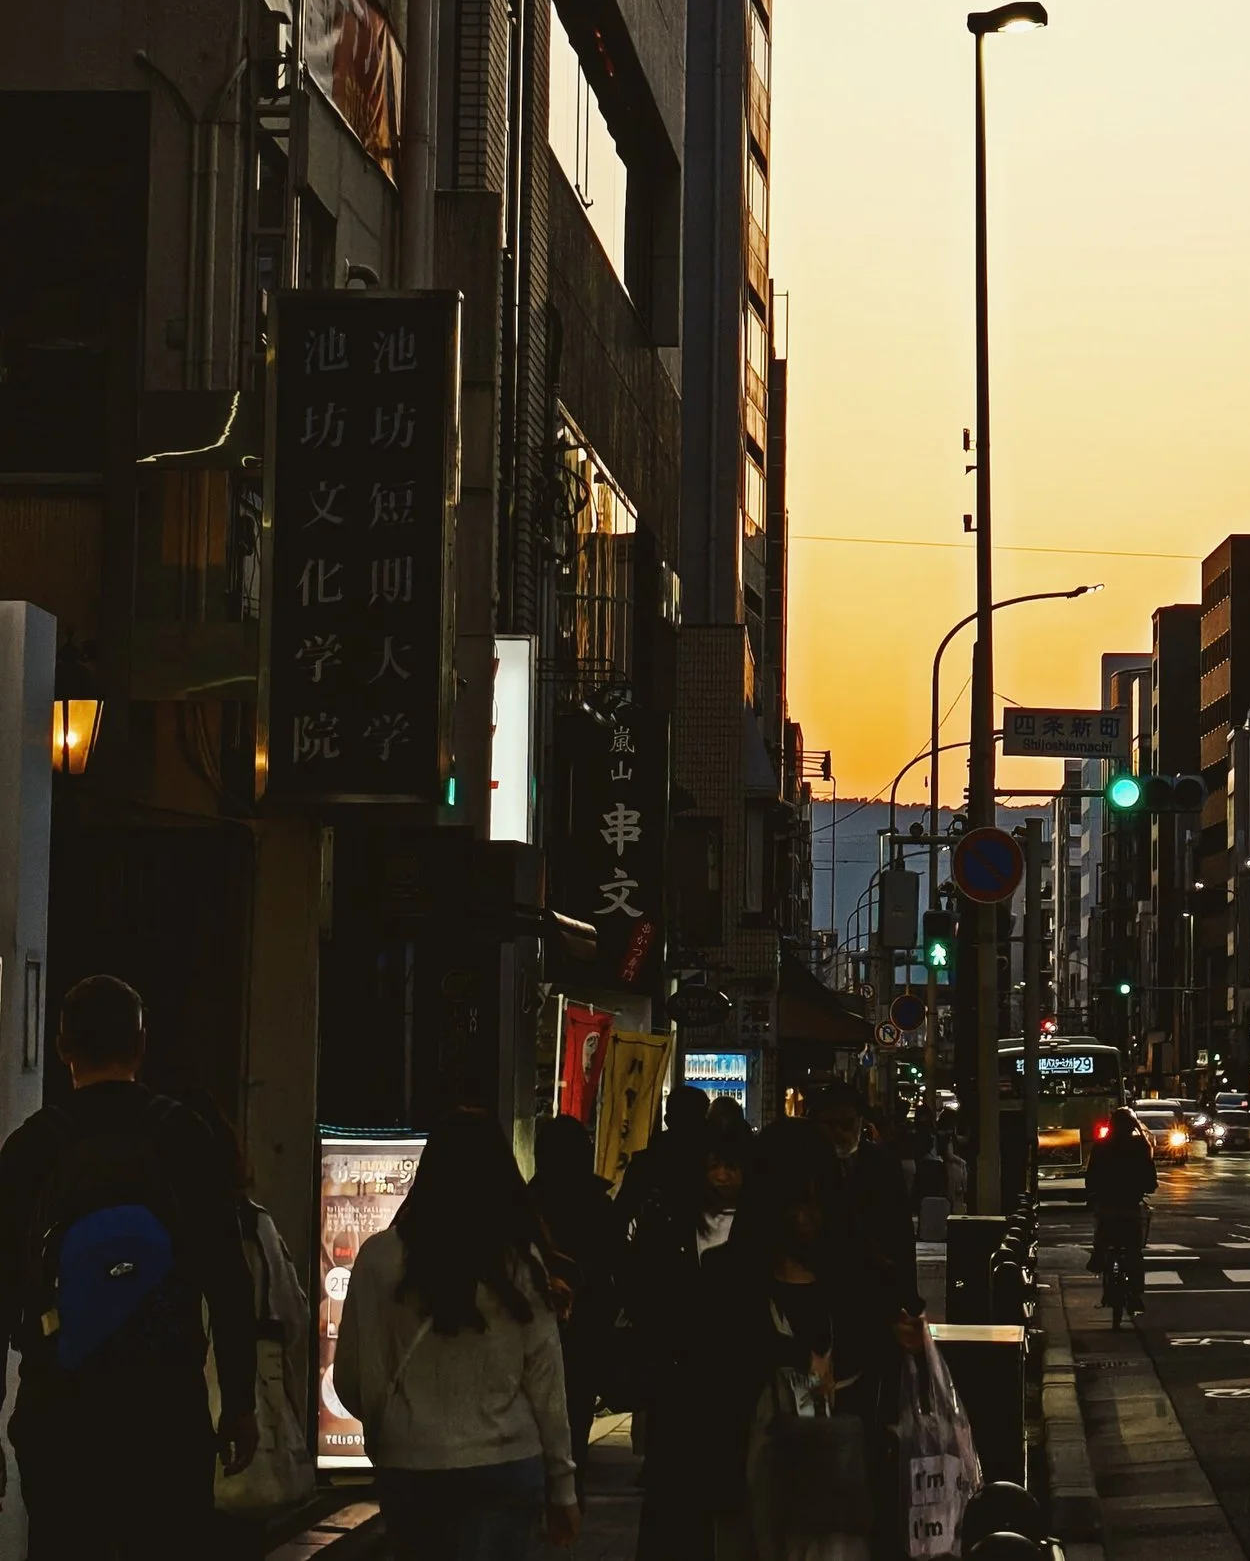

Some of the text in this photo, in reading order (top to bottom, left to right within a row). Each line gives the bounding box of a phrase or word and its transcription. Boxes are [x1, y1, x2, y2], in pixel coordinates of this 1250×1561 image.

[293, 326, 349, 764] 池坊文化学院
[363, 327, 417, 761] 池坊短期大学
[1015, 716, 1120, 738] 四条新町
[593, 726, 644, 918] 嵐山 串文
[1075, 1058, 1092, 1072] 29
[916, 1470, 945, 1491] I'm
[914, 1517, 943, 1540] I'm
